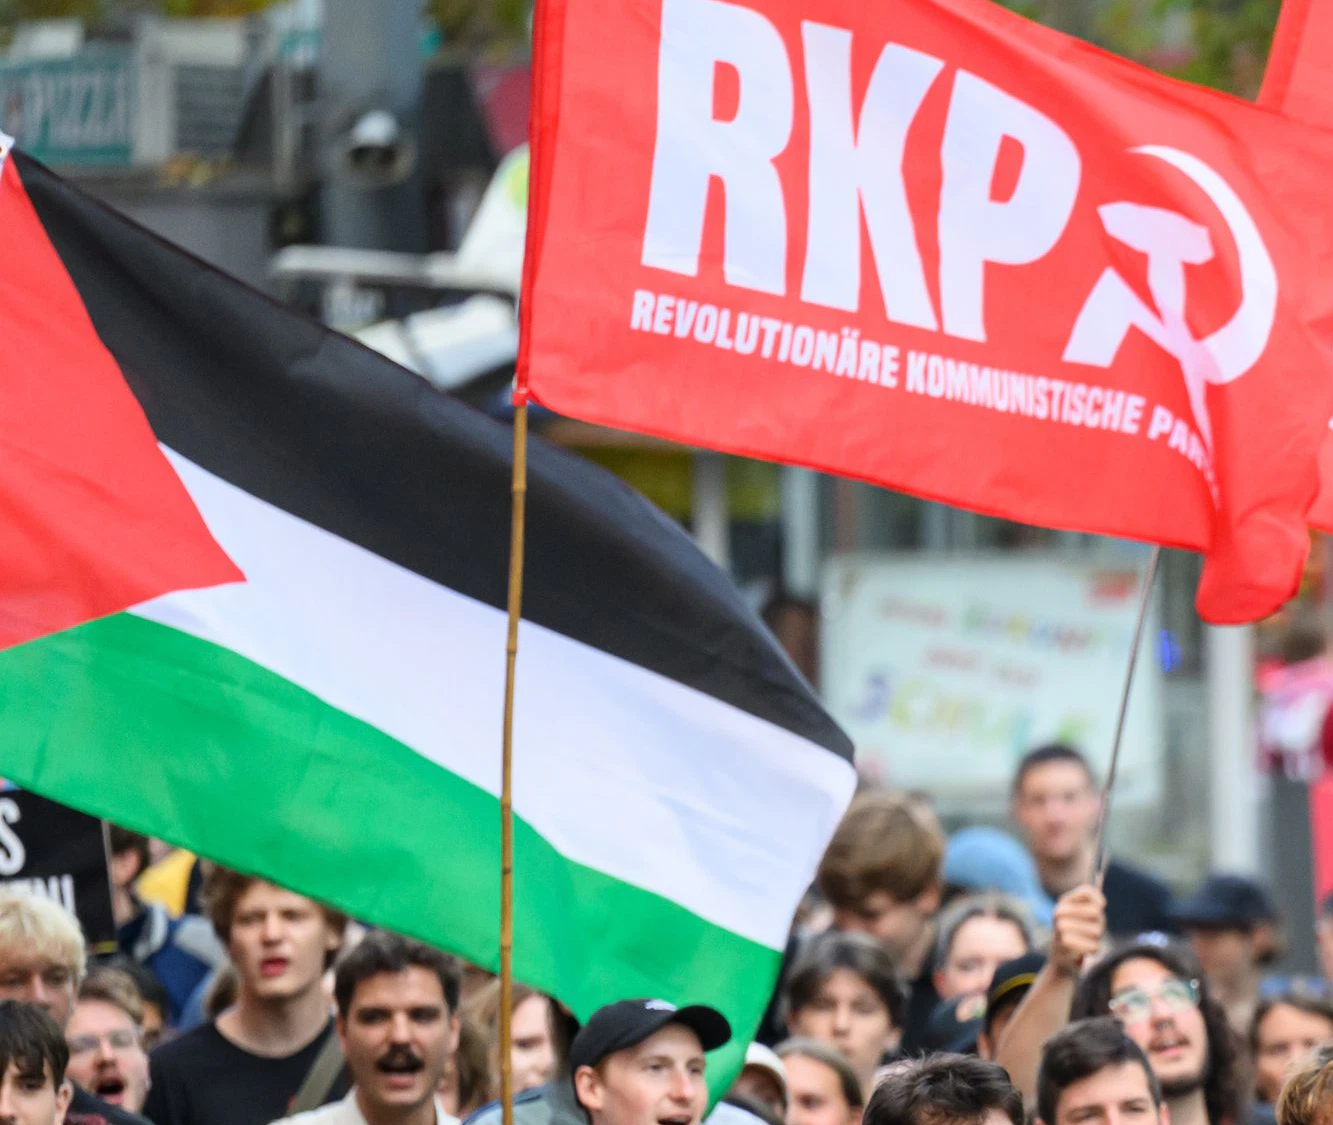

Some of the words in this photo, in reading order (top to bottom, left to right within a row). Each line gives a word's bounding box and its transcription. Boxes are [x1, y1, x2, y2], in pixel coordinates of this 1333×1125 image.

[641, 0, 1082, 343] RKP
[631, 288, 900, 390] REVOLUTIONÄRE
[905, 351, 1147, 434] KOMMUNISTISCHE
